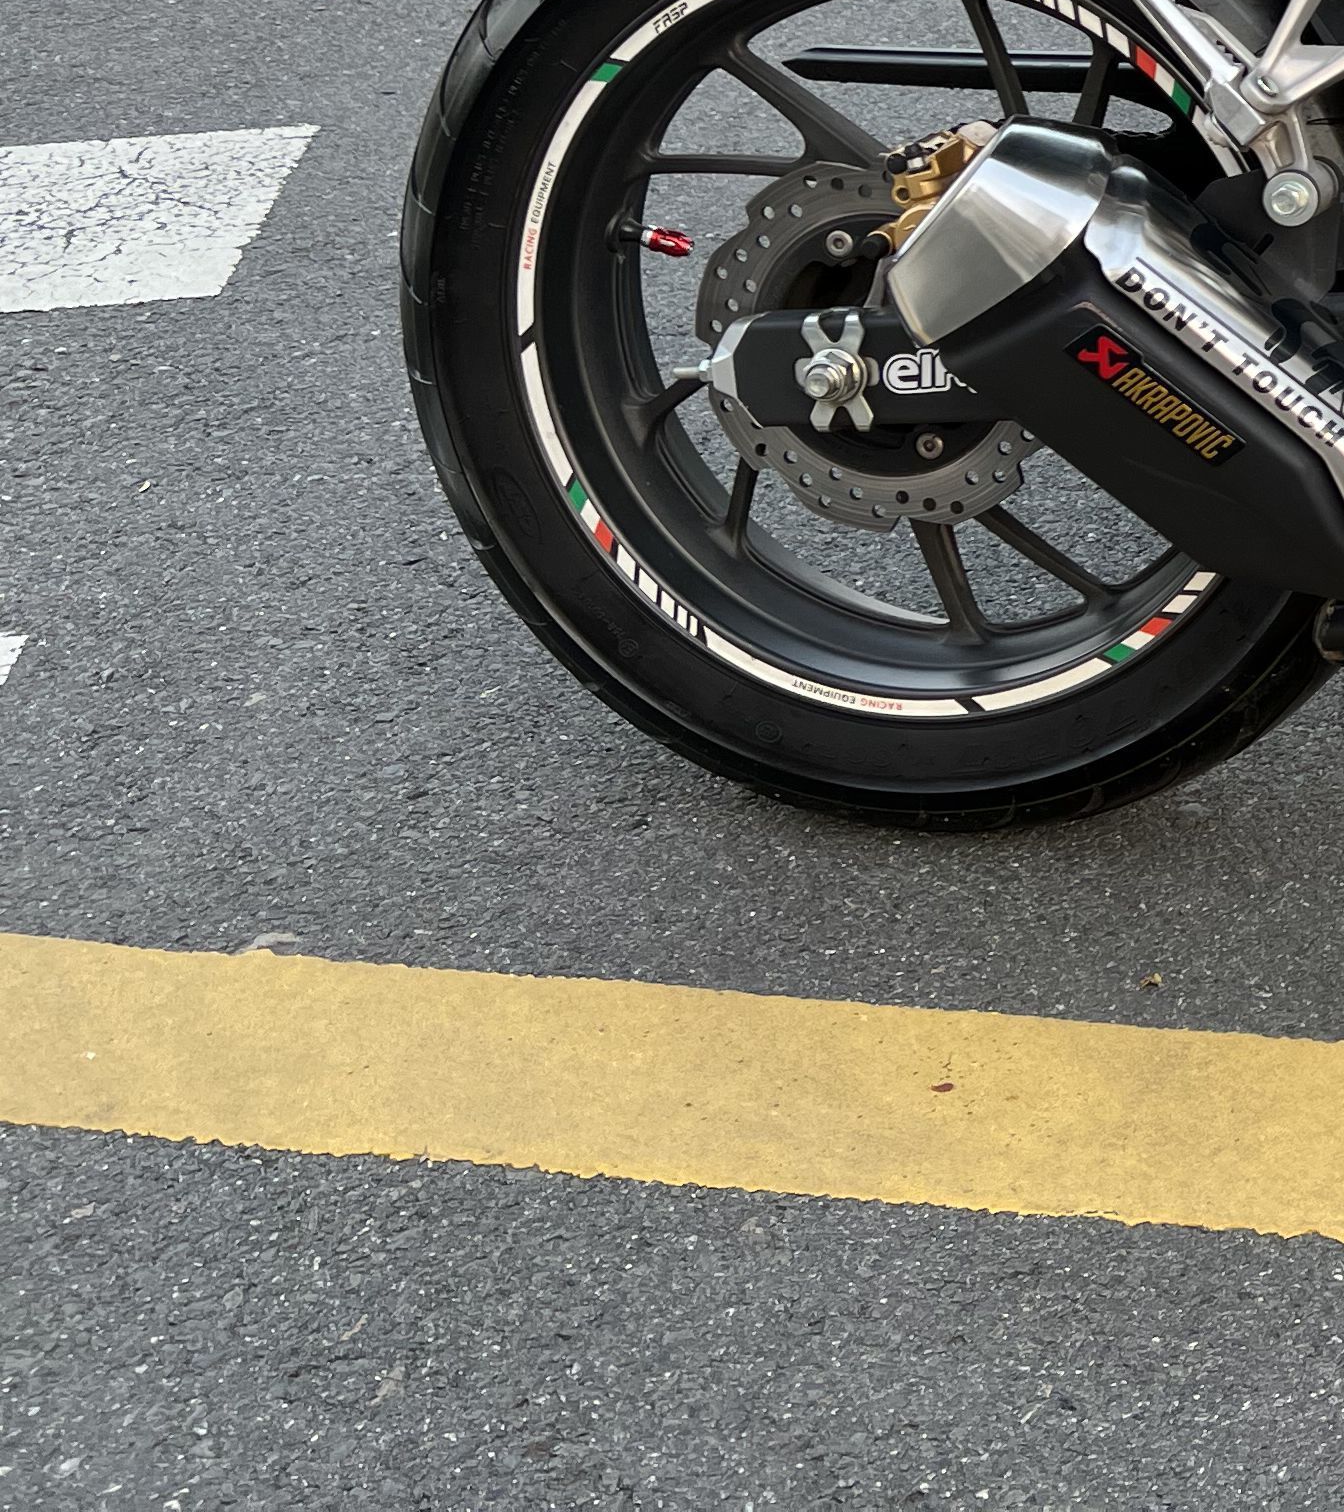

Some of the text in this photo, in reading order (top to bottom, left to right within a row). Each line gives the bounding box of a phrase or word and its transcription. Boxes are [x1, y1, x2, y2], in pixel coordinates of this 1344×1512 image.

[524, 161, 557, 271] RACING EQUIPMENT
[791, 678, 903, 712] RACING EQUIPMENT
